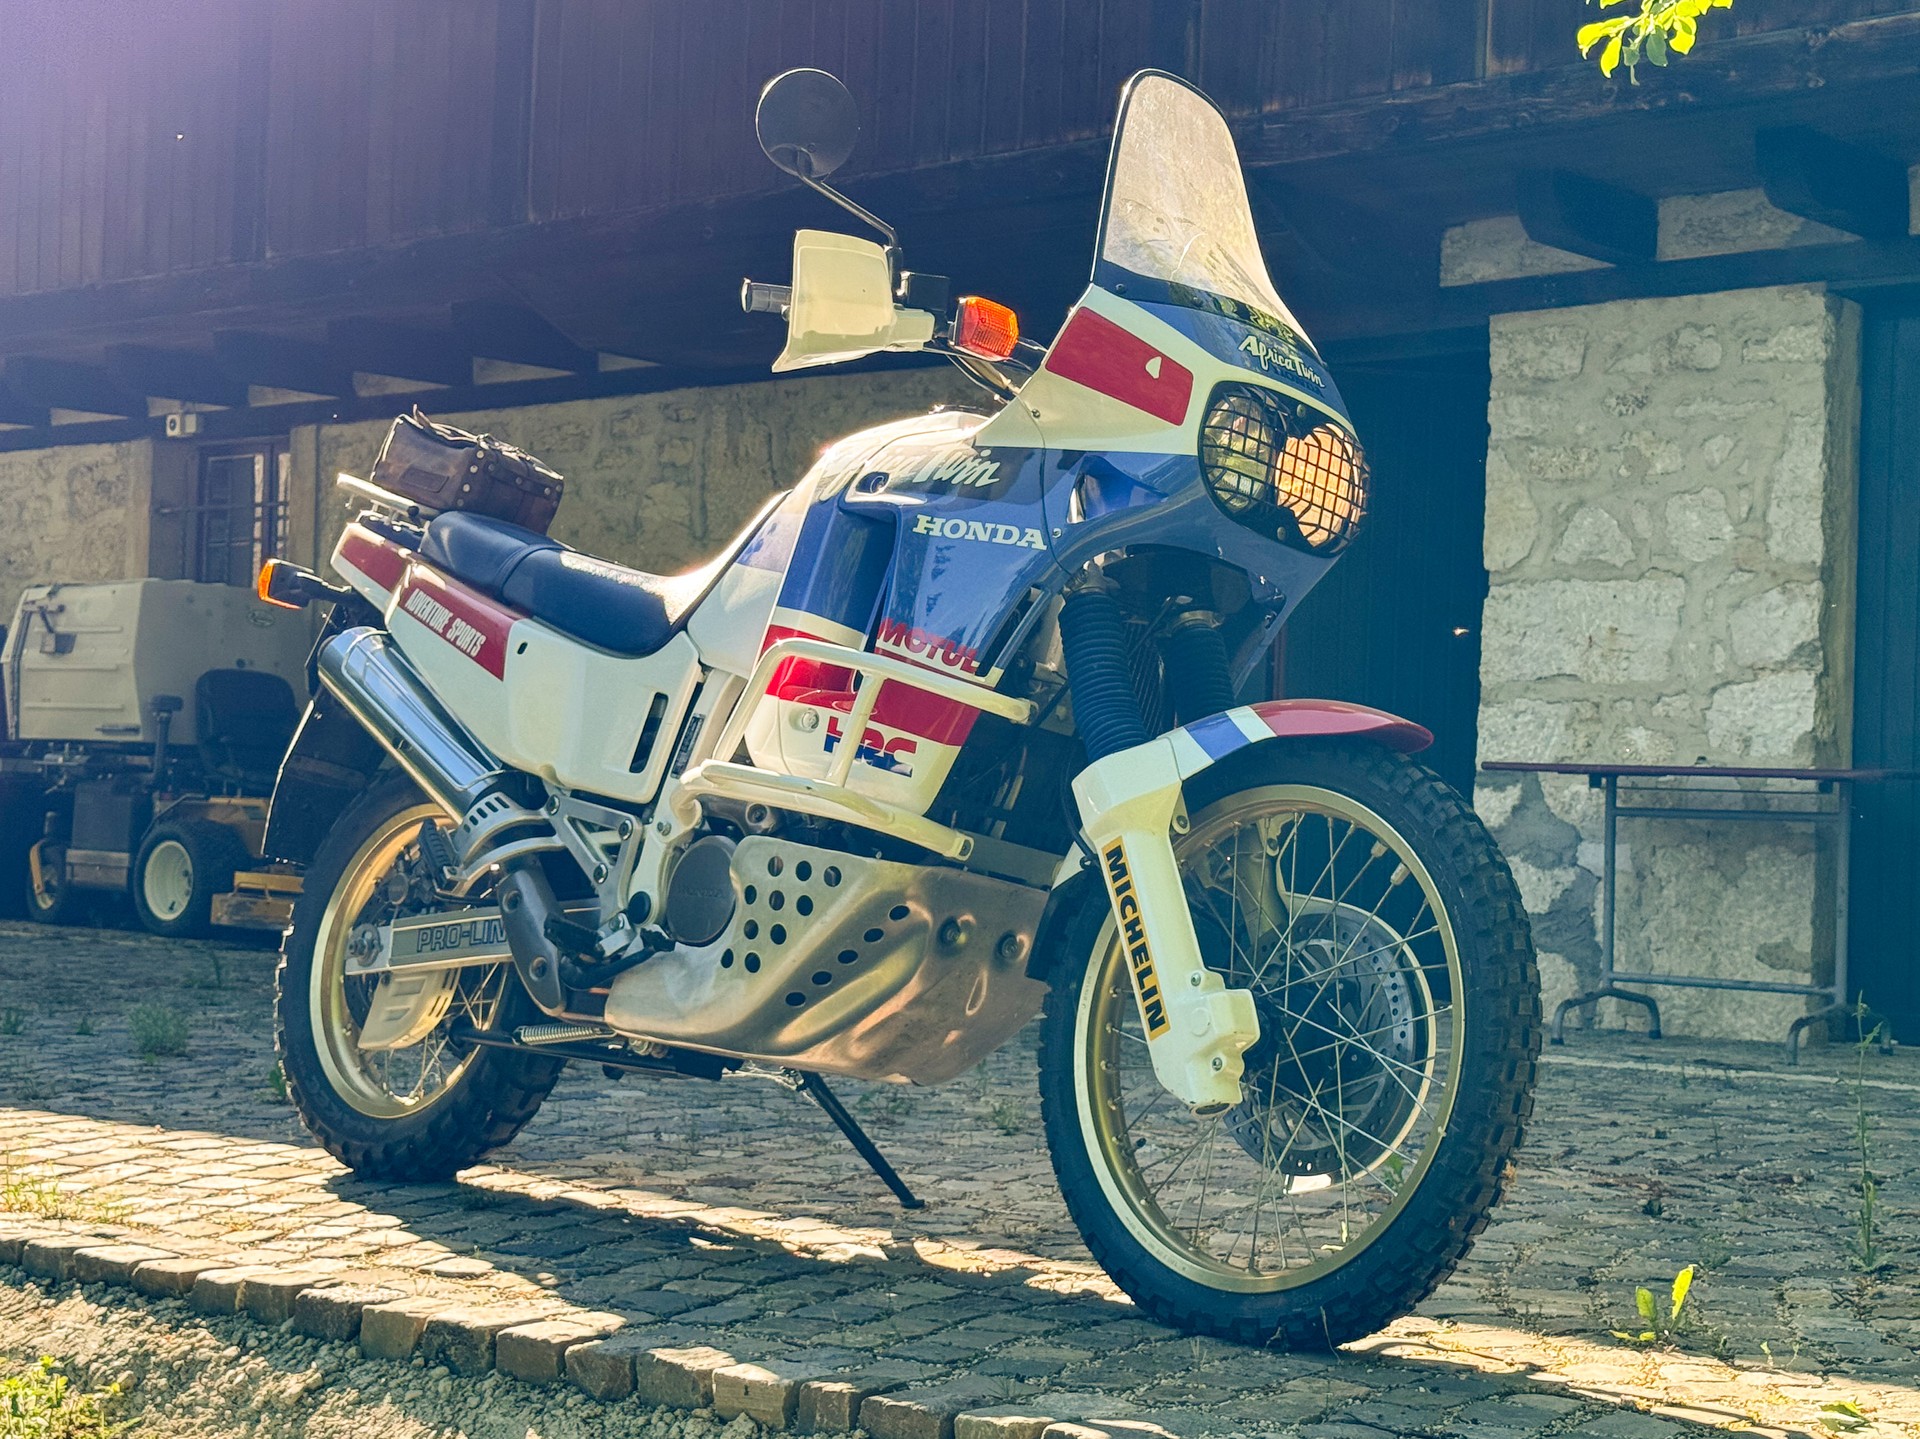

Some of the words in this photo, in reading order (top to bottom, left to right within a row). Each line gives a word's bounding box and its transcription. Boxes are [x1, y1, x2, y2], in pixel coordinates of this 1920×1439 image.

[1238, 335, 1295, 371] Africa
[1288, 354, 1325, 388] Twin
[912, 446, 1001, 488] Twin
[912, 514, 1047, 550] HONDA
[404, 588, 454, 634] ADVENTURE
[446, 617, 487, 657] SPORTS
[877, 616, 981, 676] MOTUL
[416, 918, 508, 953] PRO-LIN
[1105, 844, 1166, 1032] MICHELIN
